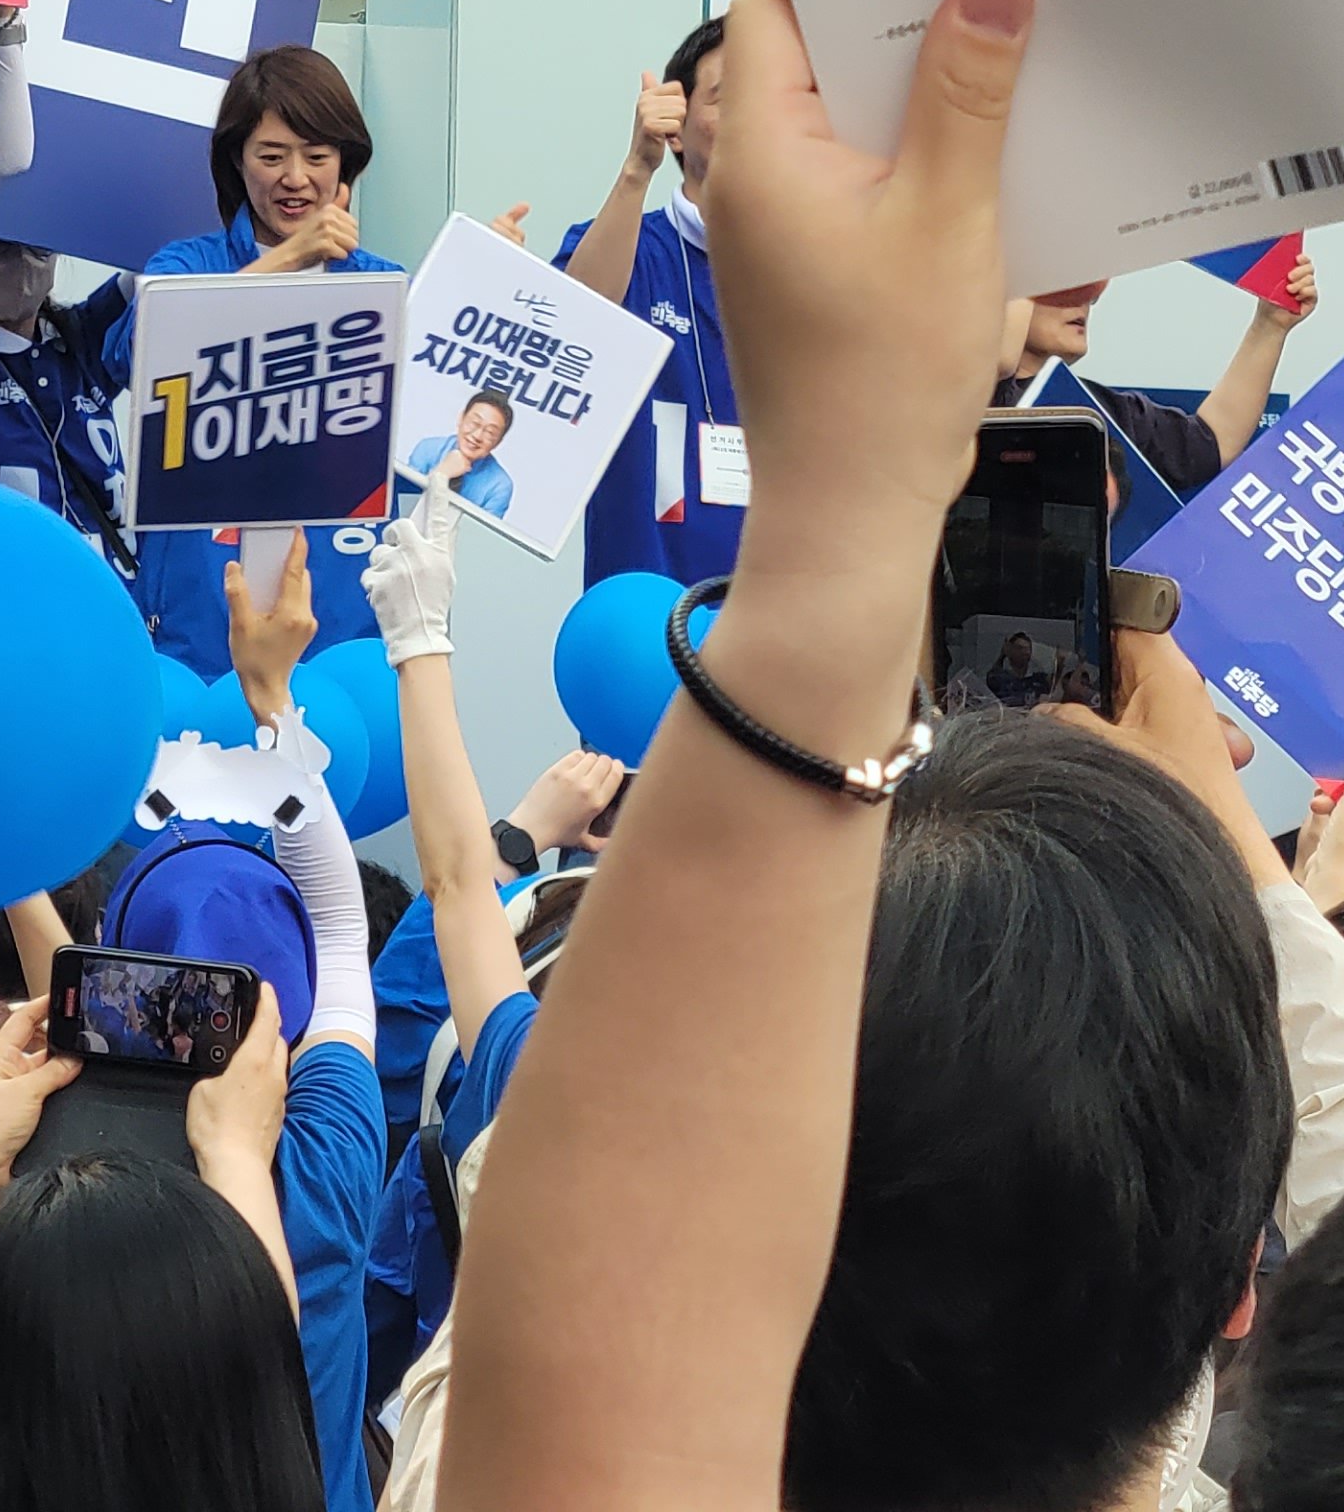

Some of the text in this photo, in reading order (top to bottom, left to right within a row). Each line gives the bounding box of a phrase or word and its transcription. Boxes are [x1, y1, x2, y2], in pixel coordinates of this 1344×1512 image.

[194, 309, 385, 400] 지금은
[412, 332, 594, 426] 지지합니다
[453, 305, 594, 384] 이재명을
[153, 371, 385, 471] 1 이재명
[651, 398, 688, 523] 1
[1223, 666, 1280, 718] 민주당
